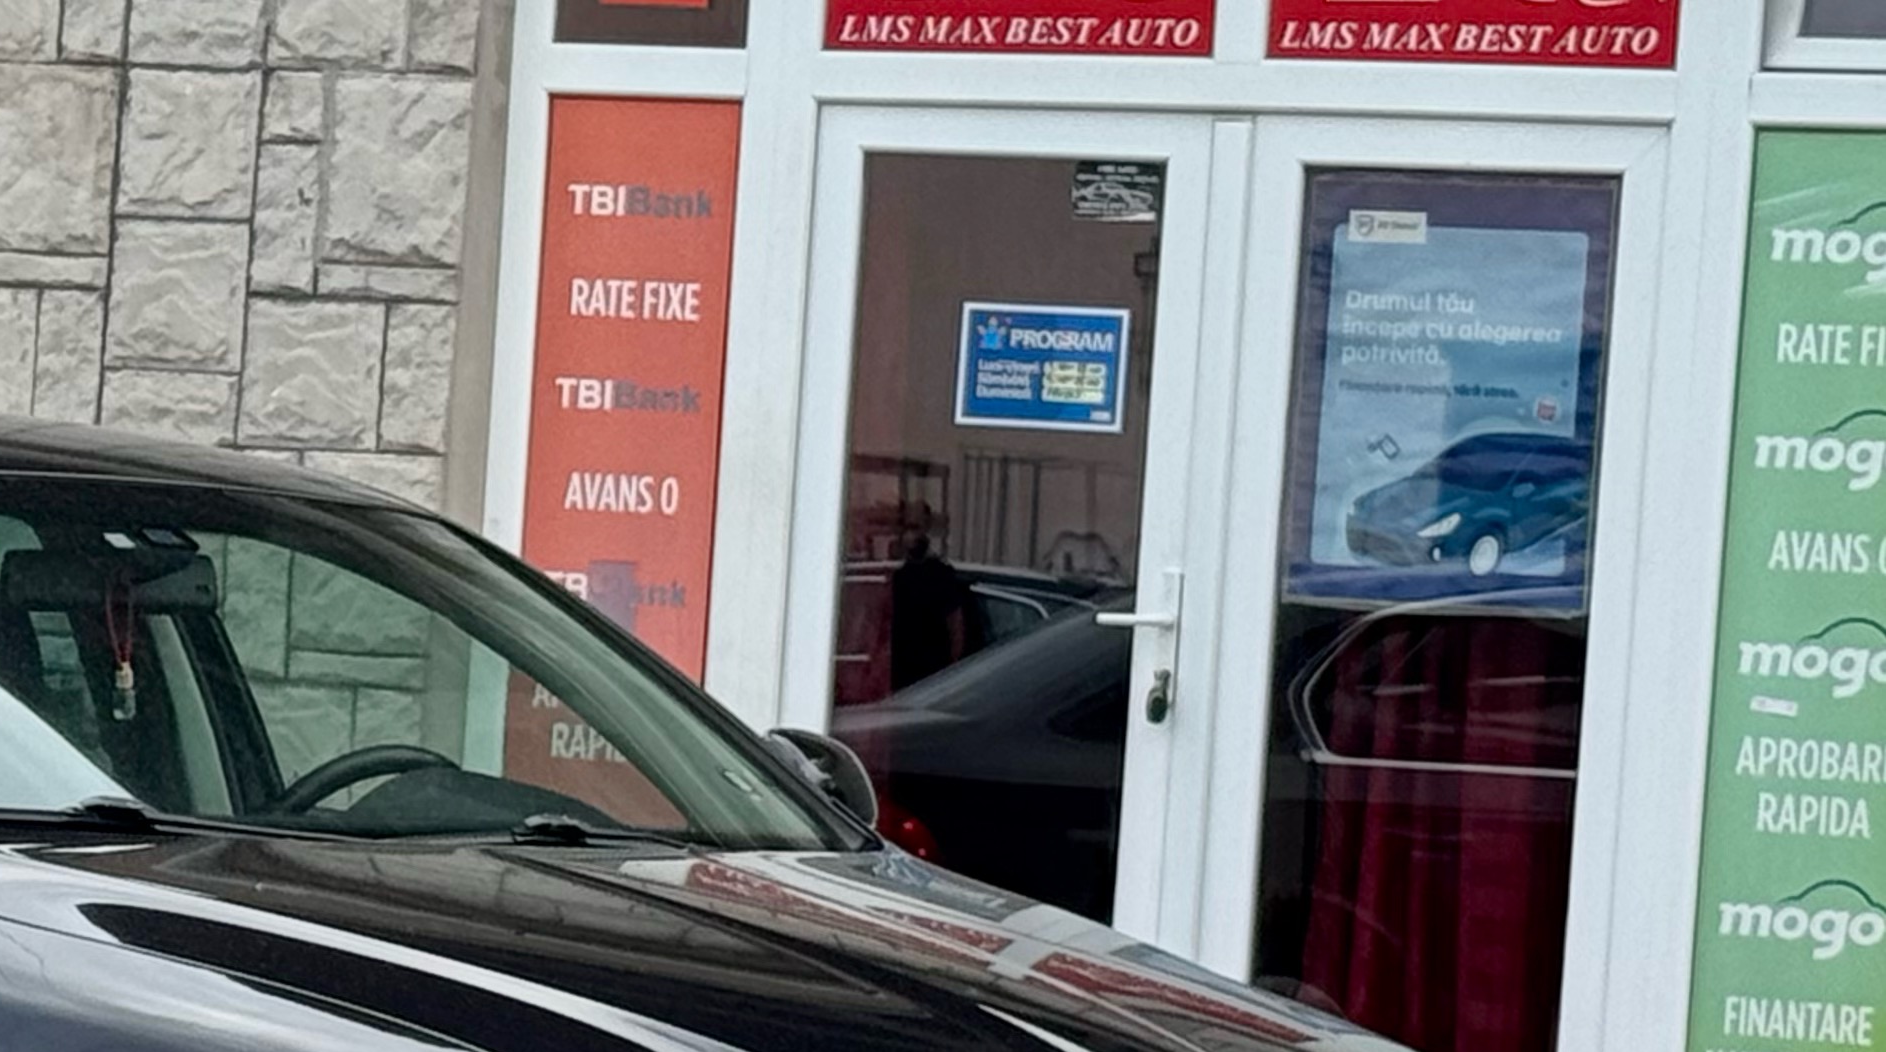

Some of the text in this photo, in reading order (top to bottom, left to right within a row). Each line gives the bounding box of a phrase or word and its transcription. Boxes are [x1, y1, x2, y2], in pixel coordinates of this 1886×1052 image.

[839, 15, 1201, 47] LMS MAX BEST AUTO
[1279, 20, 1660, 56] LMS MAX BEST AUTO
[567, 183, 713, 218] TBIBank
[570, 278, 702, 322] RATE FIXE
[1344, 289, 1430, 312] Drumul
[1009, 327, 1114, 352] PROGRAM
[1425, 320, 1454, 340] cu
[1458, 320, 1563, 346] alegerea
[1776, 322, 1853, 366] RATE
[1754, 435, 1886, 491] mog
[564, 471, 655, 514] AVANS
[1767, 530, 1872, 574] AVANS
[1735, 734, 1886, 784] APROBAR
[1756, 790, 1871, 839] RAPIDA
[1717, 902, 1886, 960] mogo
[1723, 995, 1875, 1047] FINANTARE
